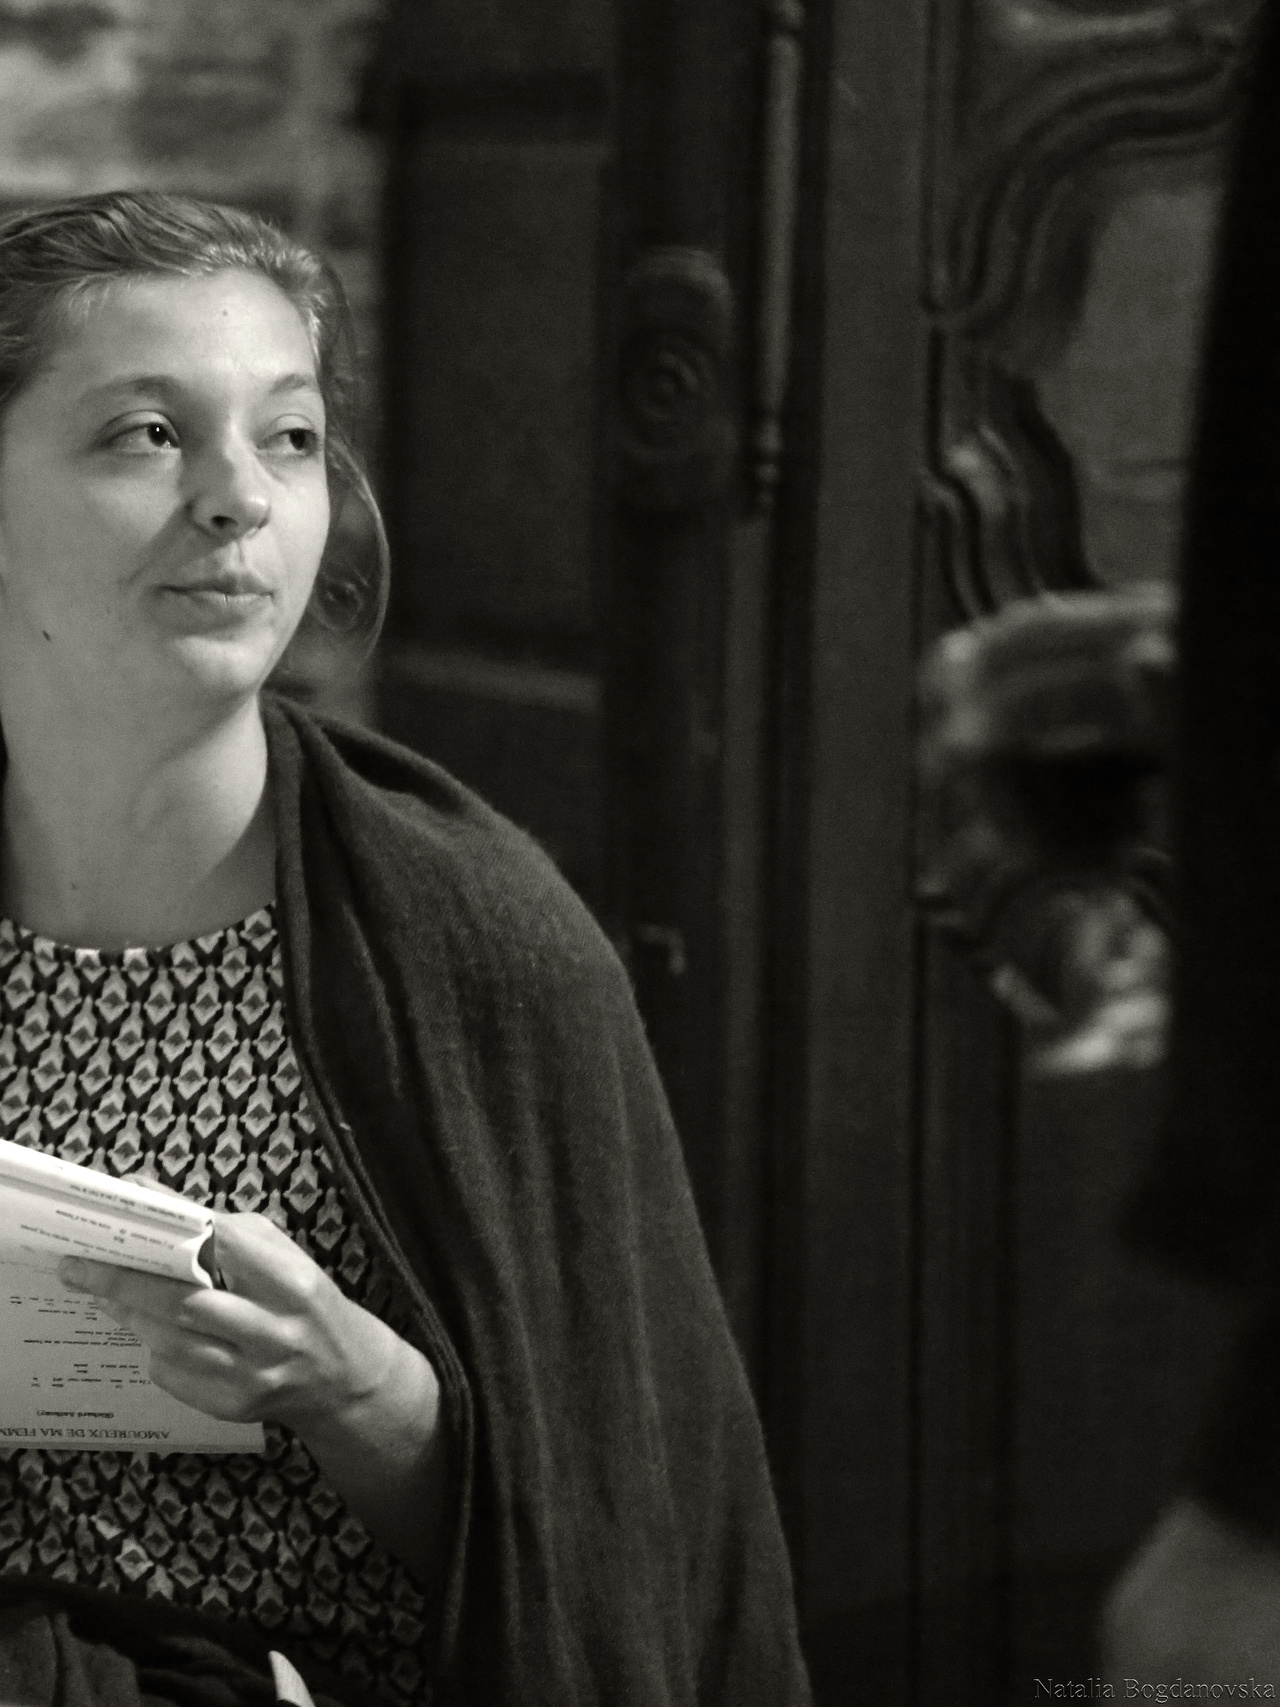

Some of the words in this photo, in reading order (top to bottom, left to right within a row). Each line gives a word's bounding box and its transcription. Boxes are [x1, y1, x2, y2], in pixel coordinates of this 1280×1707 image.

[40, 1428, 63, 1437] MA
[66, 1429, 85, 1438] DE
[89, 1429, 170, 1440] AMOUREUX
